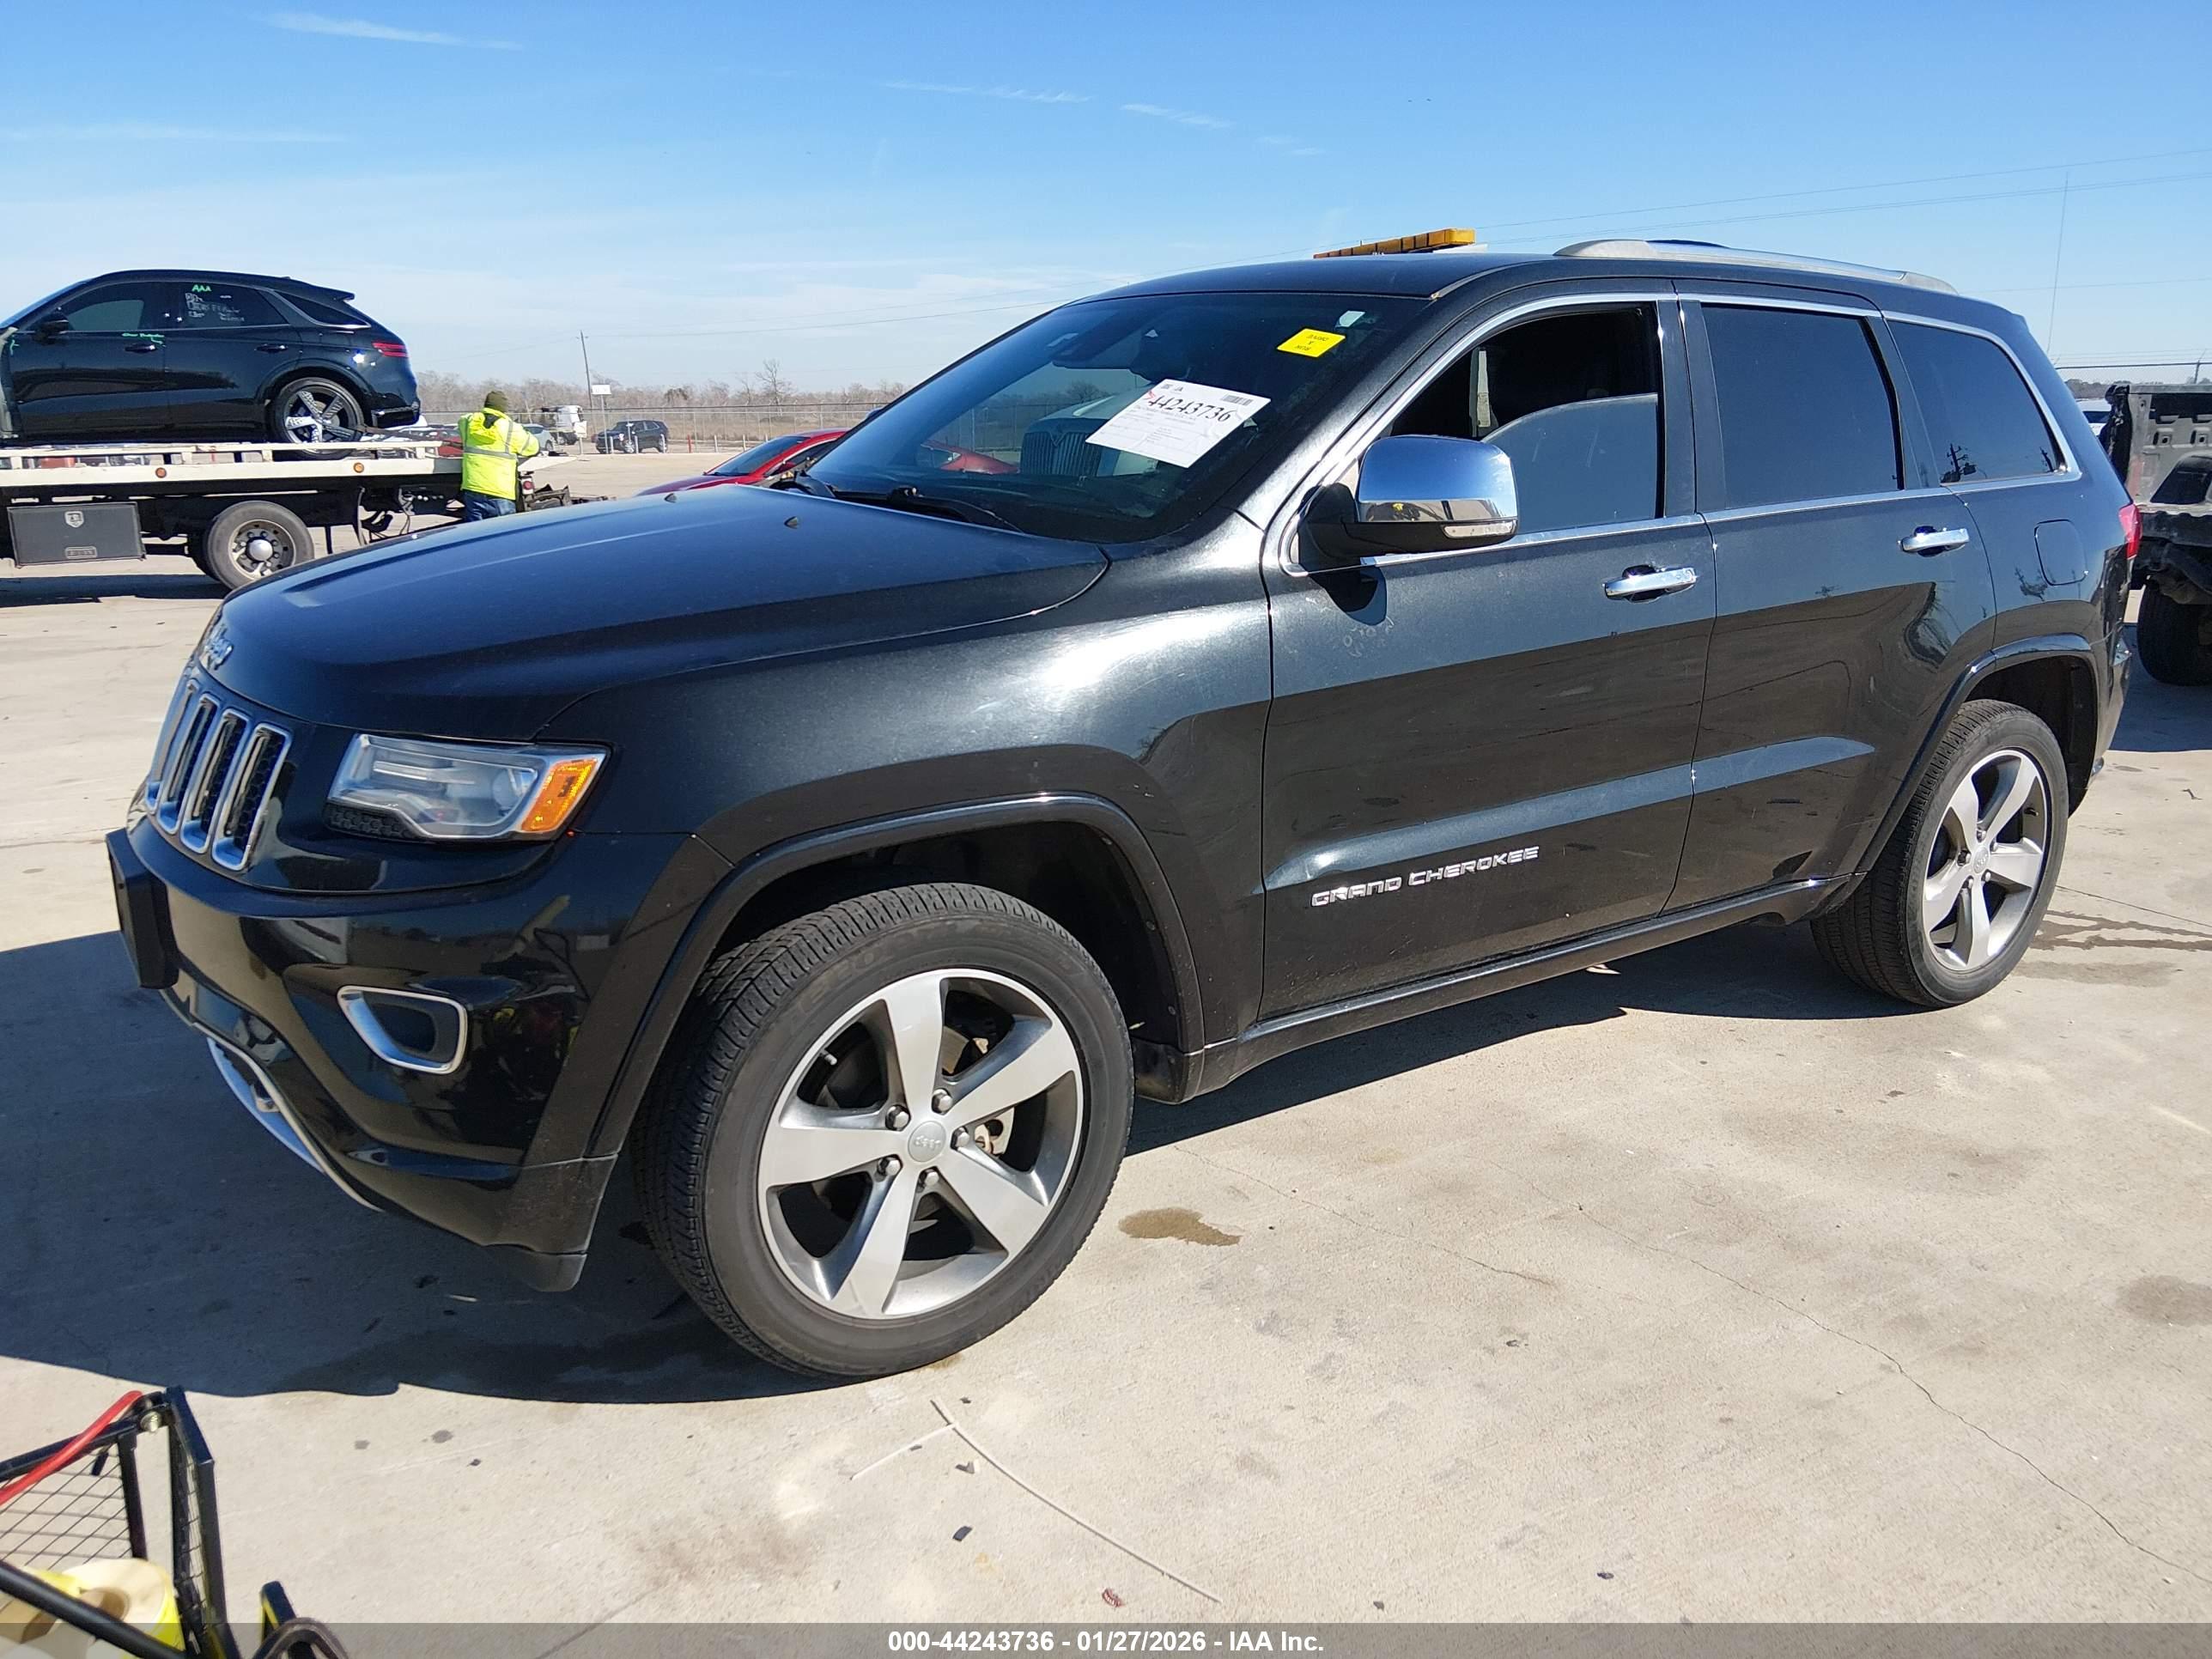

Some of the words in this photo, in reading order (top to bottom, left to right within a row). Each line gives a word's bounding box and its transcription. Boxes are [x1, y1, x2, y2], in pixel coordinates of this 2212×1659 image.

[1148, 395, 1237, 422] 44243736
[1311, 876, 1402, 907] GRAND
[1407, 846, 1540, 886] CHEROKEE
